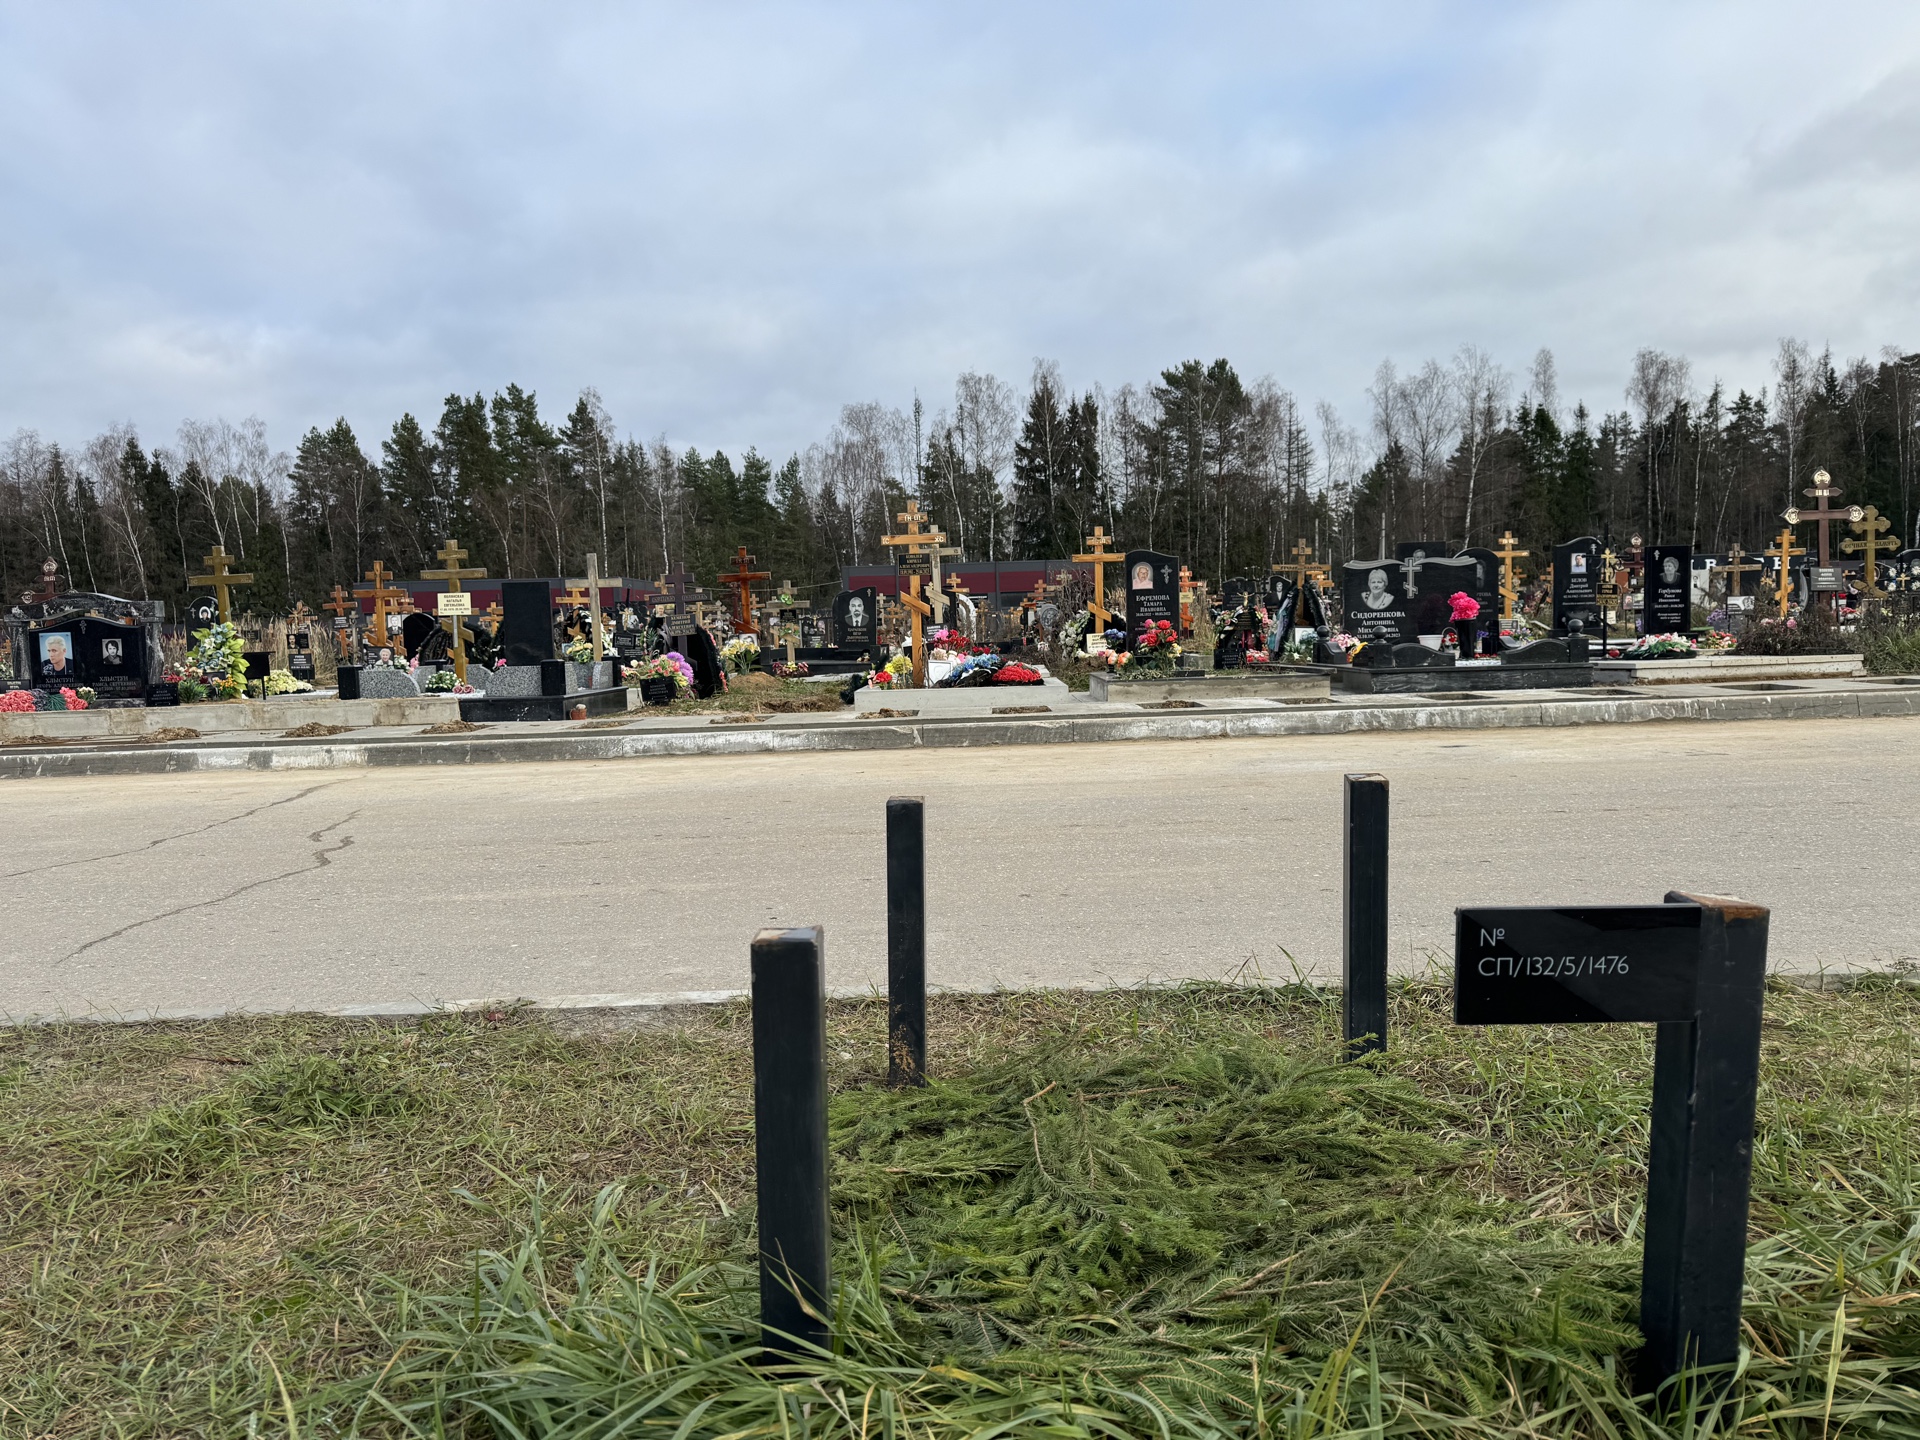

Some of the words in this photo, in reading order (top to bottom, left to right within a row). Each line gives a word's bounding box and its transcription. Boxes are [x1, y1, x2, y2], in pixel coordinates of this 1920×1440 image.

[1351, 611, 1406, 619] СИДОРЕНКОВА
[1479, 927, 1505, 947] №
[1478, 956, 1630, 978] СП/132/5/1476
